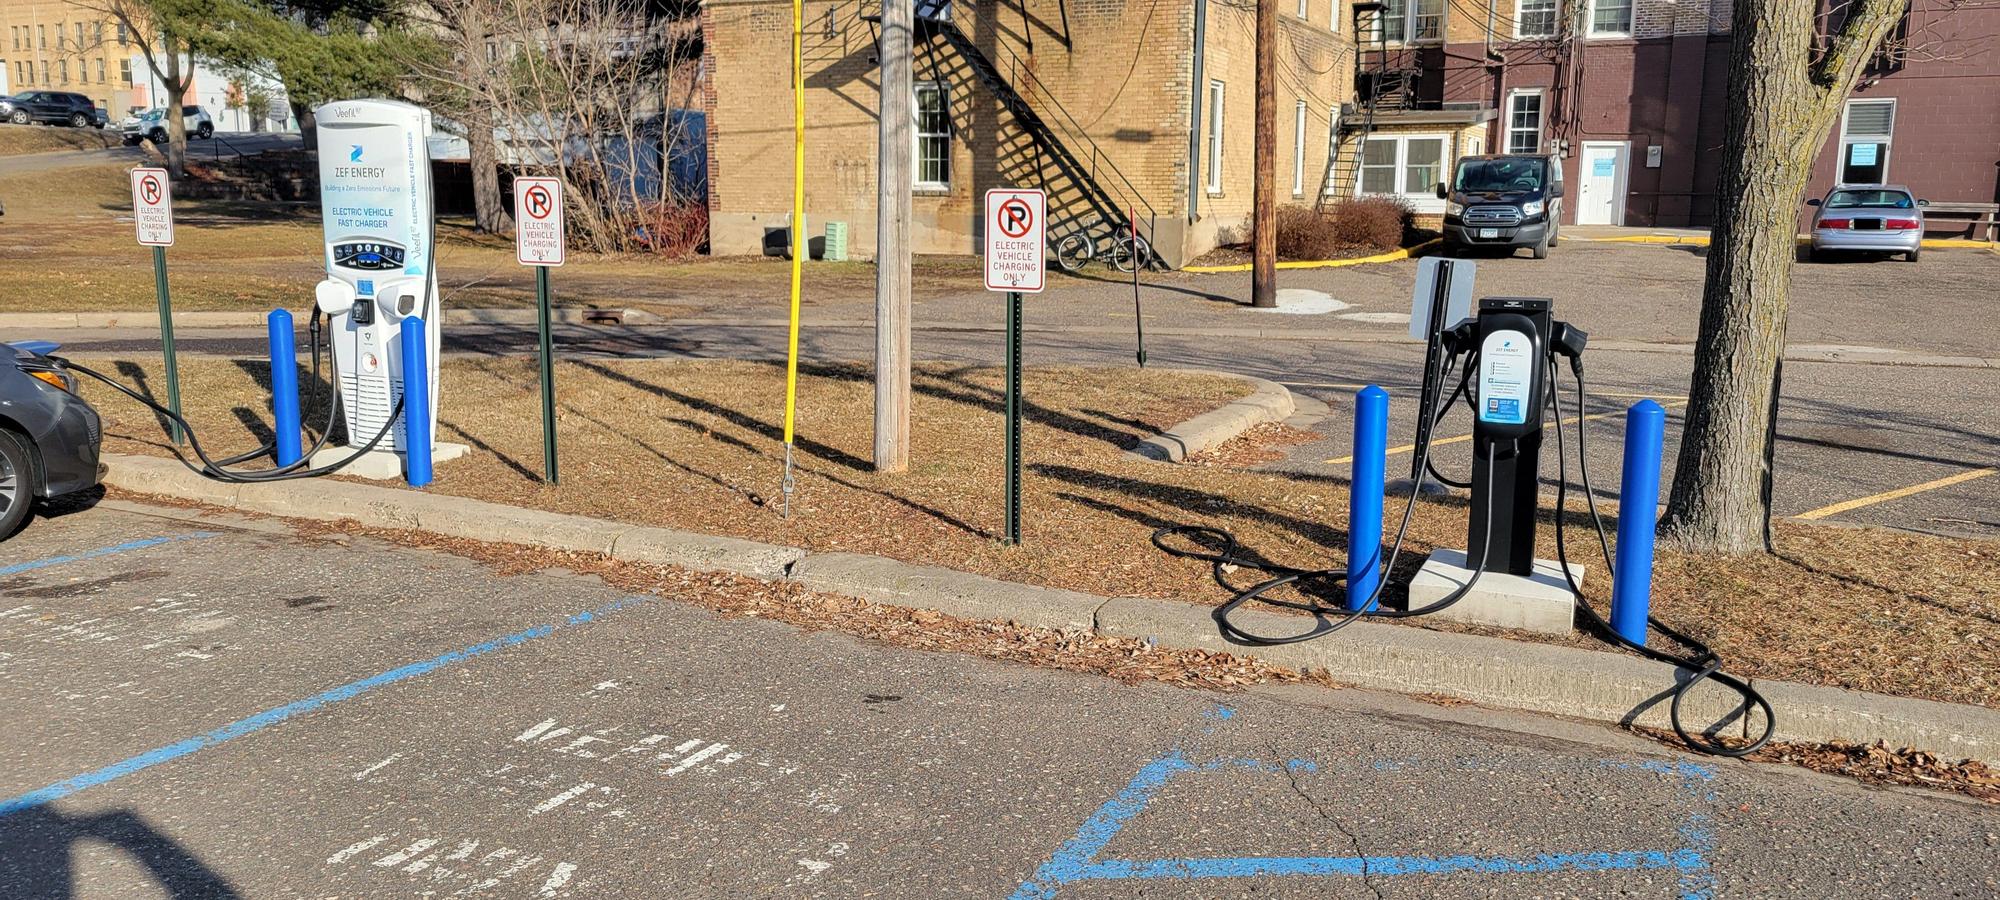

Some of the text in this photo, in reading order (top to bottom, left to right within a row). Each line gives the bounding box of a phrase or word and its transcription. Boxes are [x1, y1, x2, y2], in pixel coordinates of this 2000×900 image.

[335, 107, 356, 118] Veefil
[335, 167, 385, 178] ZEF ENERGY
[382, 184, 400, 192] Future
[141, 207, 165, 215] ELECTRIC
[332, 207, 394, 217] ELECTRIC VEHICLE
[338, 219, 388, 228] FAST CHARGER
[524, 221, 555, 230] ELECTRIC
[526, 230, 554, 239] VEHICLE
[523, 239, 557, 248] CHARGING
[995, 241, 1035, 250] ELECTRIC
[532, 248, 550, 257] ONLY
[997, 252, 1033, 261] VEHICLE
[993, 262, 1037, 271] CHARGING
[1003, 272, 1026, 282] ONLY
